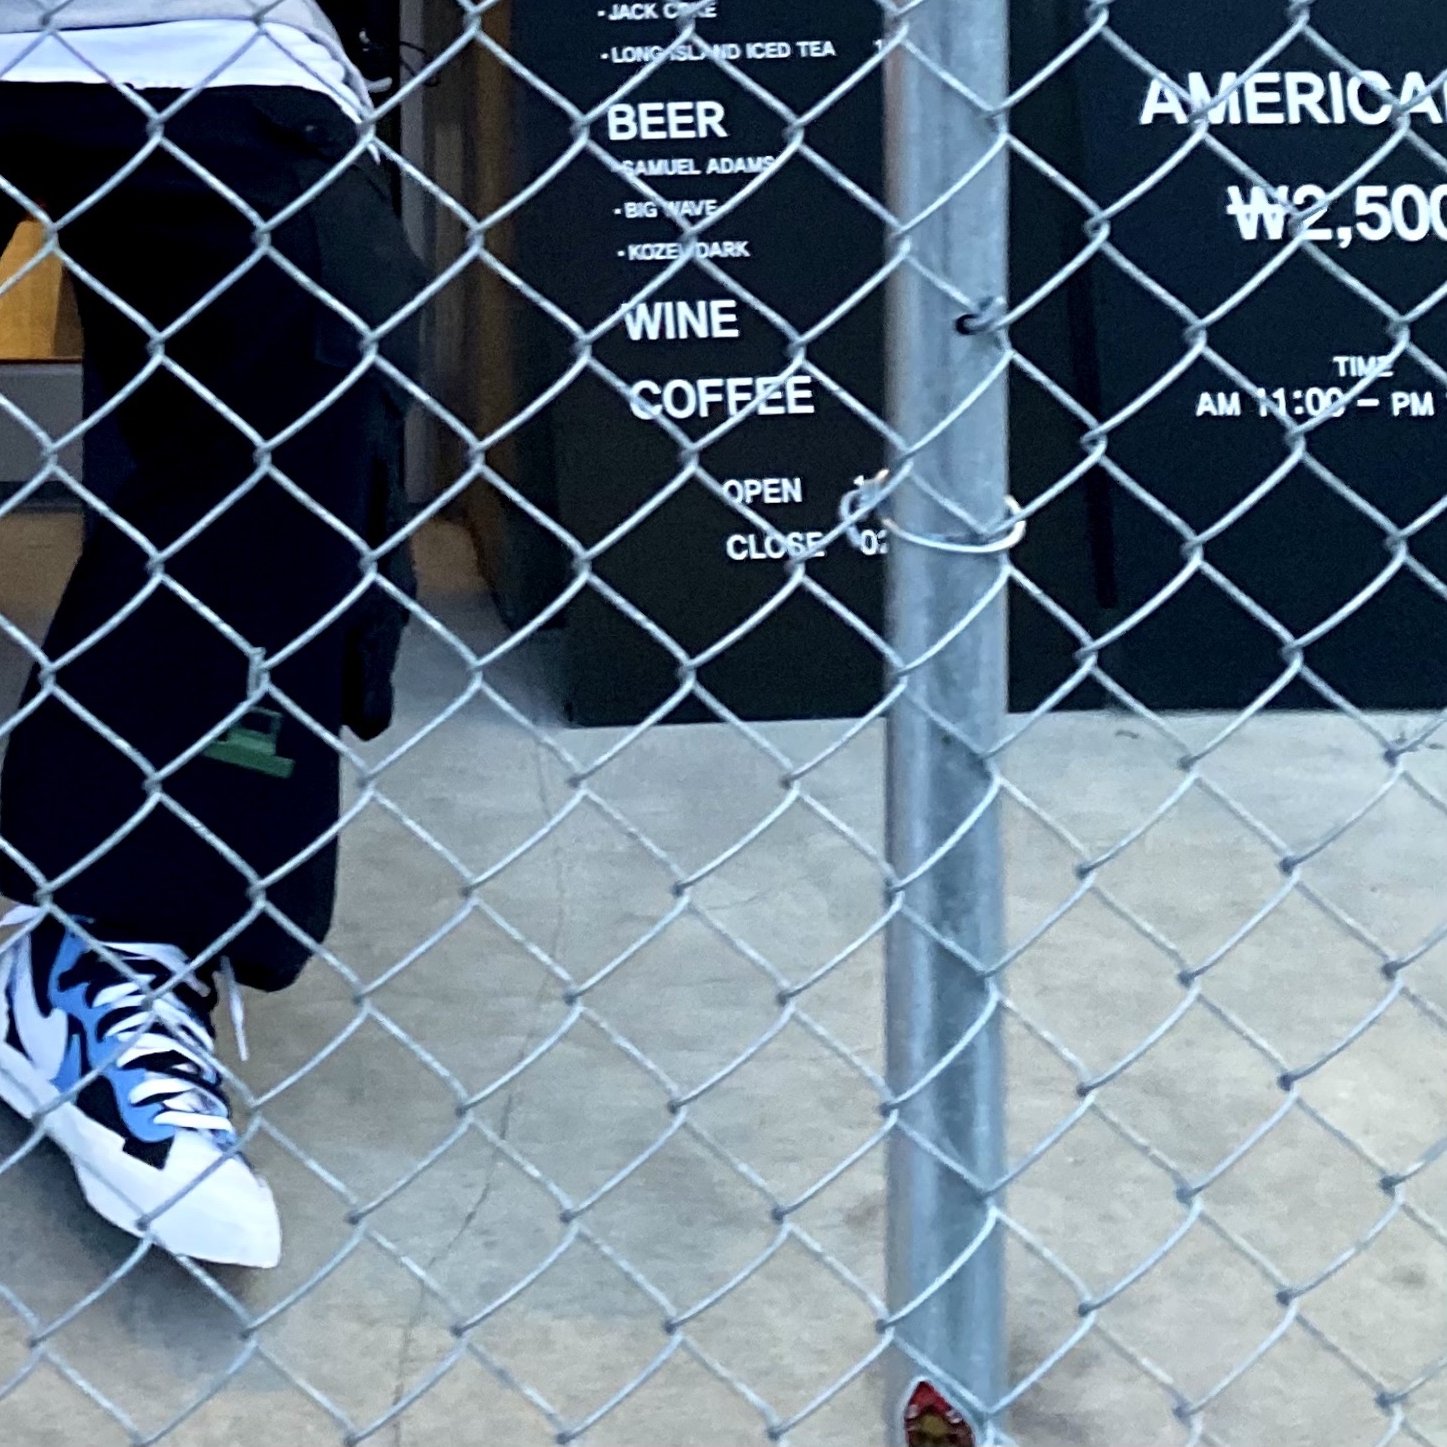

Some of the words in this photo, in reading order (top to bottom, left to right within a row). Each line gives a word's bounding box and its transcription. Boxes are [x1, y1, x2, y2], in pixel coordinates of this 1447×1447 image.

[608, 3, 659, 21] JACK
[663, 2, 717, 19] CE
[745, 42, 792, 59] ICED
[796, 40, 837, 58] TEA
[1139, 71, 1447, 125] AMERICA
[607, 101, 728, 141] BEER
[622, 158, 702, 177] SAMUEL
[706, 156, 776, 175] ADAMS
[624, 202, 658, 219] BIG
[697, 241, 751, 258] DARK
[622, 300, 739, 341] WINE
[630, 375, 815, 420] COFFEE
[1196, 392, 1241, 417] AM
[1256, 386, 1346, 418] 11:00
[1391, 391, 1435, 416] PM
[722, 478, 803, 504] OPEN
[726, 532, 826, 560] CLOSE
